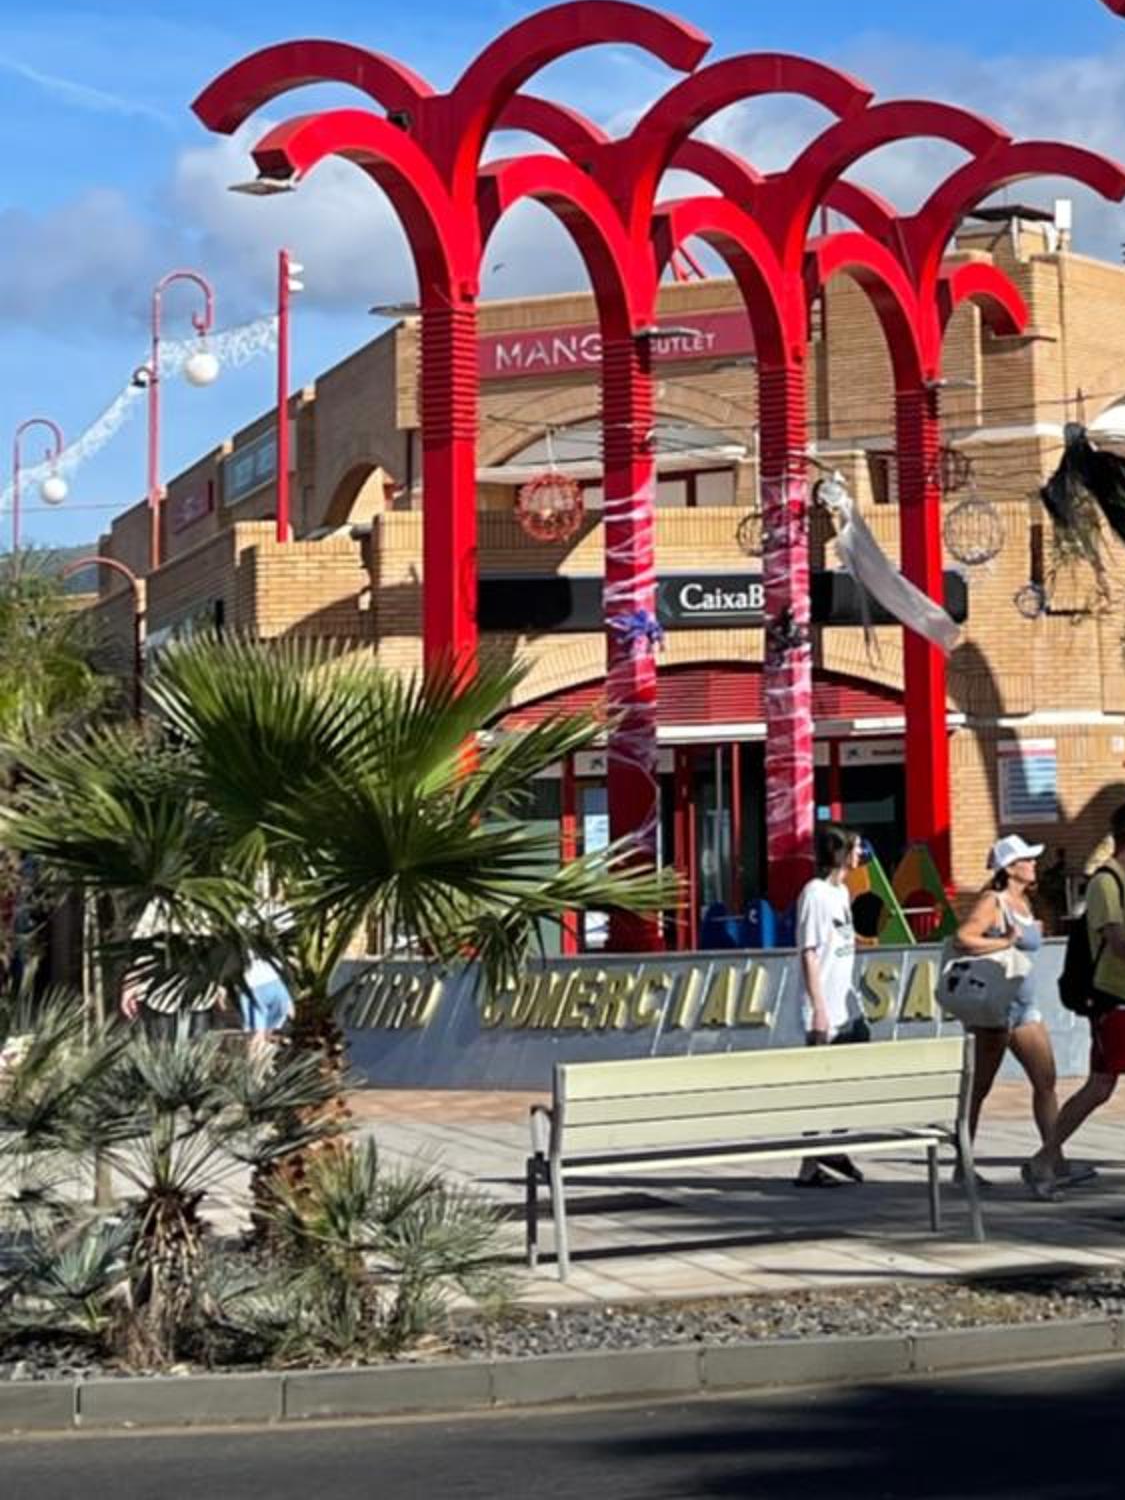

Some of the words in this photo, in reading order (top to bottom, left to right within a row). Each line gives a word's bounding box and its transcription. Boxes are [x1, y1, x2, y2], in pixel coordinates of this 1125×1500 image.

[496, 333, 602, 370] MANG
[679, 583, 766, 611] CaixaB
[482, 964, 776, 1030] COMERCIAL
[862, 959, 952, 1022] SA
